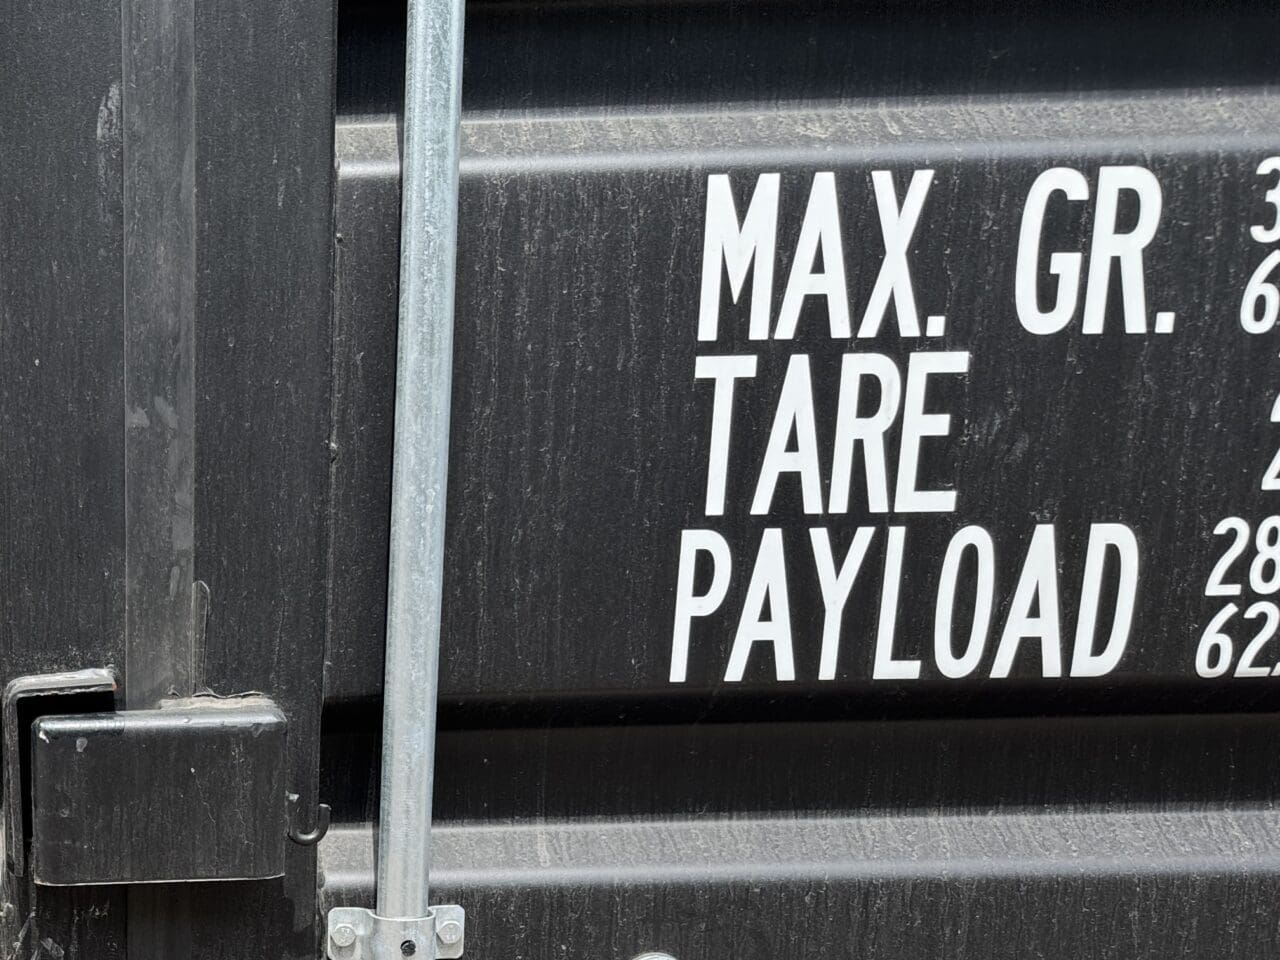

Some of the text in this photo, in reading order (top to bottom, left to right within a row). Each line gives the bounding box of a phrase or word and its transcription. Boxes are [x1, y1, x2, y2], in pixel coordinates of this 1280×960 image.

[697, 165, 1176, 341] MAX. GR.
[694, 351, 970, 516] TARE
[669, 523, 1139, 683] PAYLOAD
